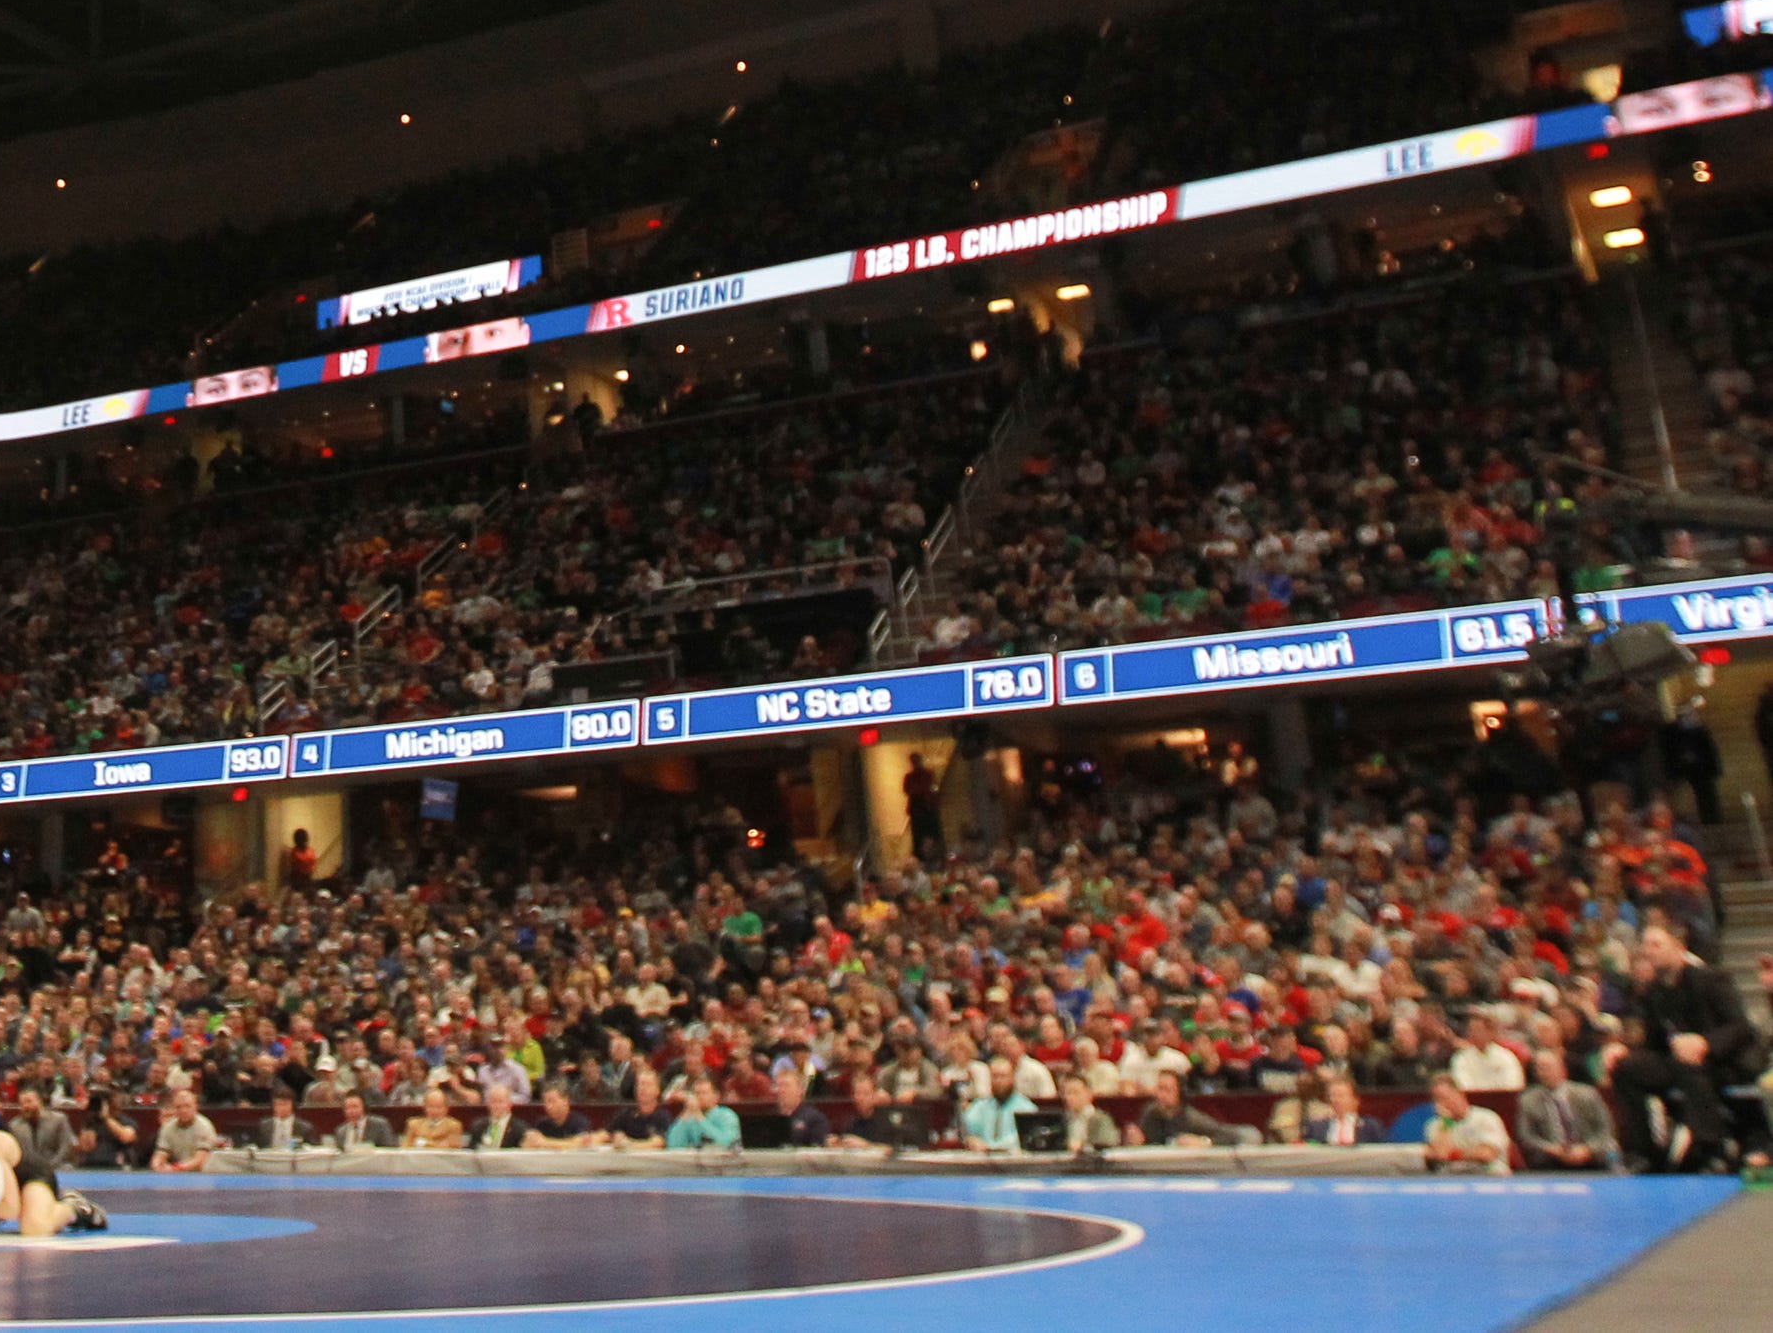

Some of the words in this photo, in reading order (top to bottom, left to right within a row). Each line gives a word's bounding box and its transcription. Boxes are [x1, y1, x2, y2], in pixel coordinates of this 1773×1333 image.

[1382, 140, 1436, 179] LEE
[864, 241, 911, 279] 125
[914, 235, 956, 269] LB.
[960, 190, 1168, 260] CHAMPIONSHIP
[429, 277, 467, 293] DIVISION
[605, 298, 633, 327] R
[644, 277, 745, 320] SURIANO
[337, 350, 369, 378] VS
[61, 404, 92, 429] LEE
[1073, 662, 1097, 691] 6
[1193, 631, 1355, 683] Missouri
[1450, 612, 1536, 654] 61.5
[655, 708, 676, 732] 5
[755, 691, 802, 724] NC
[805, 683, 893, 719] State
[976, 666, 1043, 702] 76.0
[300, 742, 318, 765] 4
[385, 725, 504, 760] Michigan
[570, 708, 633, 742] 80.0
[1, 771, 17, 793] 3
[93, 760, 151, 788] Iowa
[230, 744, 281, 773] 93.0
